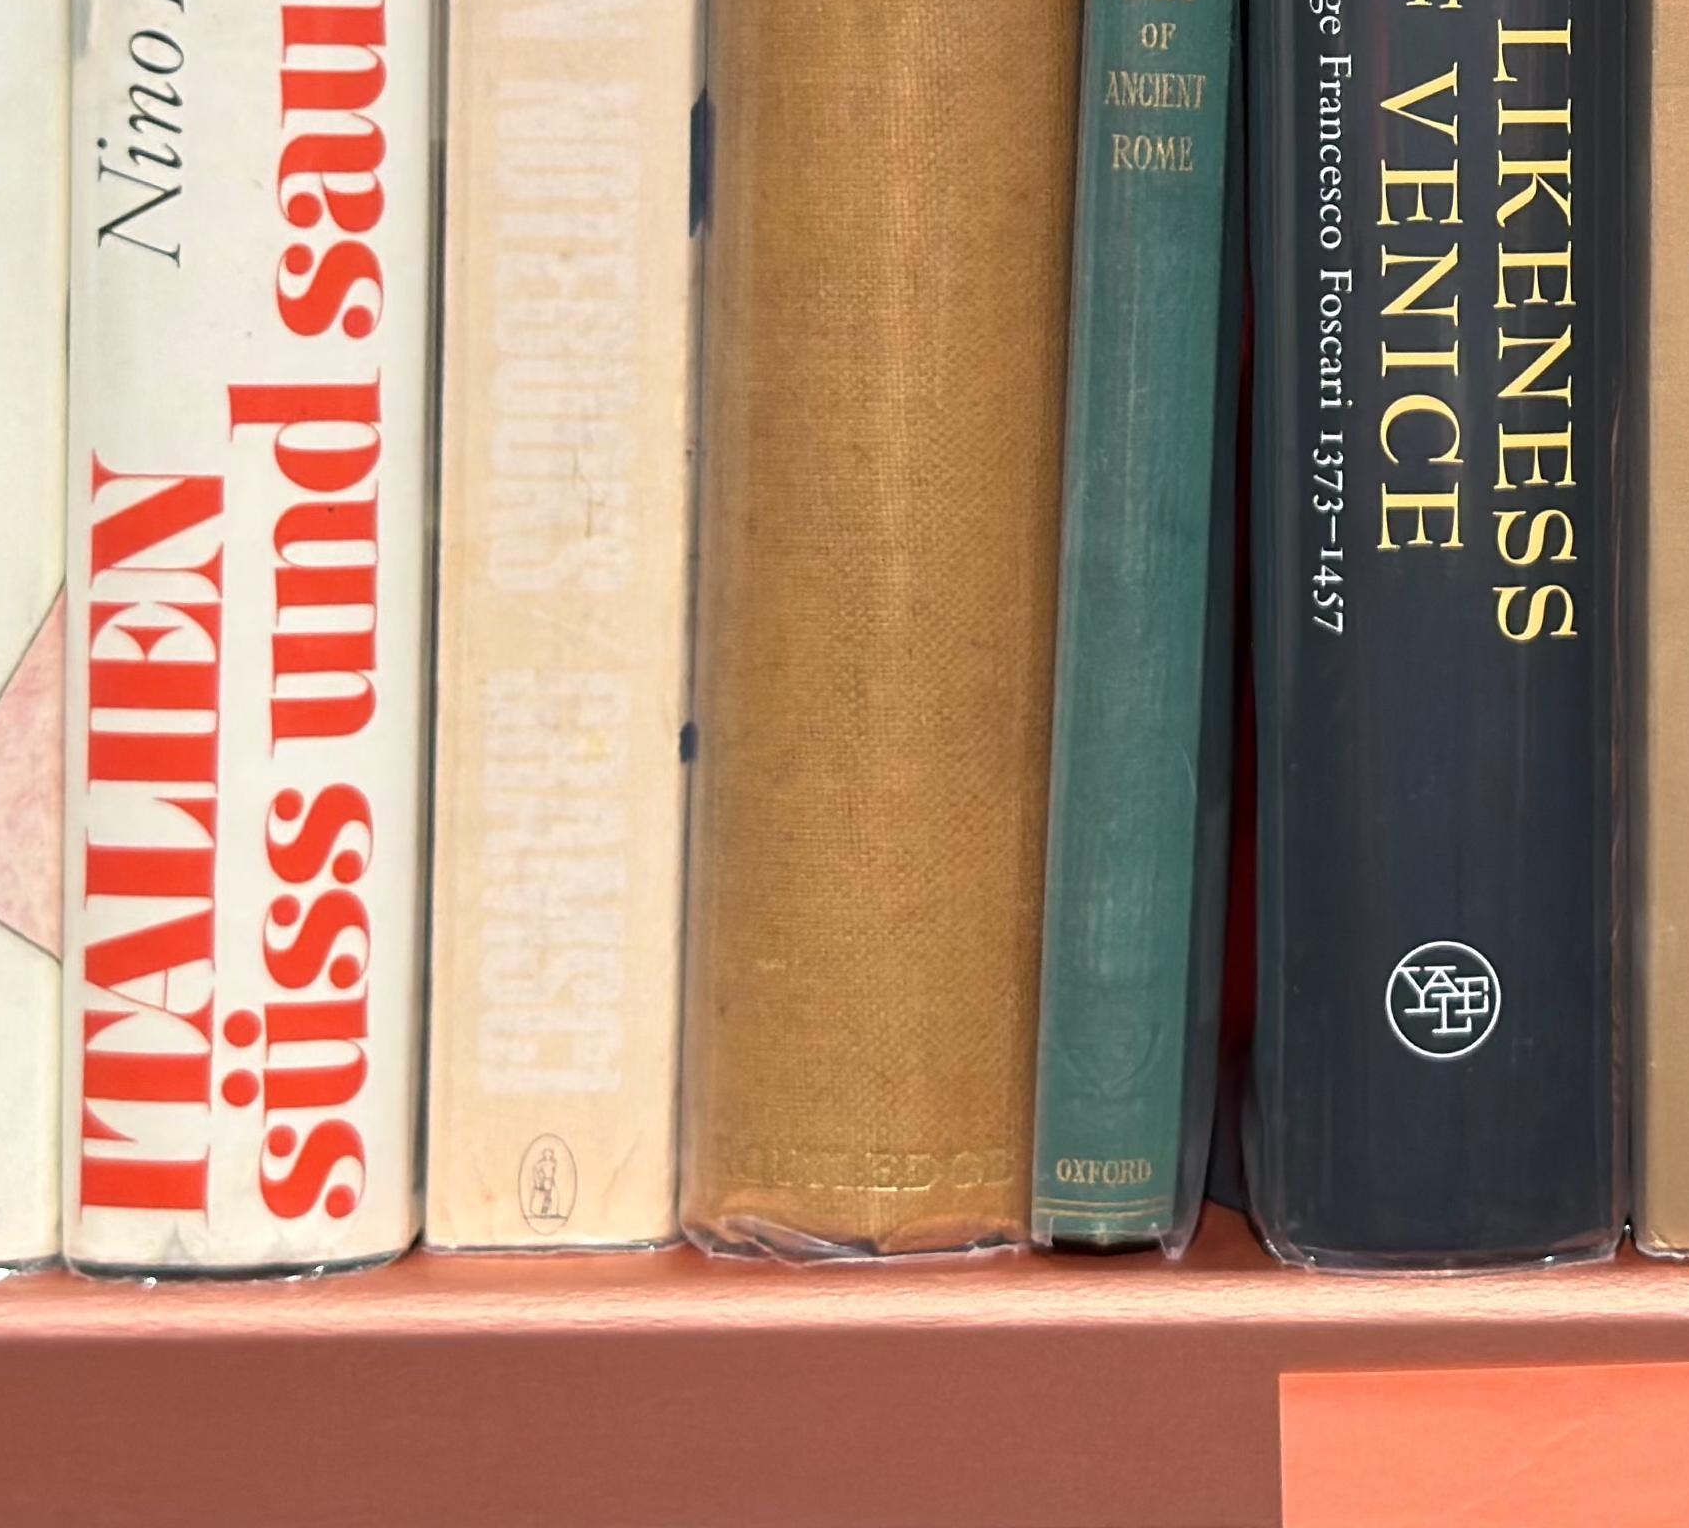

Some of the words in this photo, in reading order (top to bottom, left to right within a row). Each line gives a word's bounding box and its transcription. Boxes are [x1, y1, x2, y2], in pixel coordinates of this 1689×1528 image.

[1110, 71, 1205, 107] ANCIENT
[1141, 23, 1176, 49] OF
[97, 30, 184, 267] Nino
[1113, 134, 1192, 170] ROME
[1320, 54, 1351, 249] Francesco
[1320, 269, 1353, 408] Foscari
[1377, 62, 1464, 550] VENICE
[1492, 19, 1577, 641] LIKENESS
[227, 366, 381, 759] und
[79, 447, 225, 1222] ITALIEN
[219, 783, 373, 1220] süss
[1056, 1160, 1151, 1184] OXFORD
